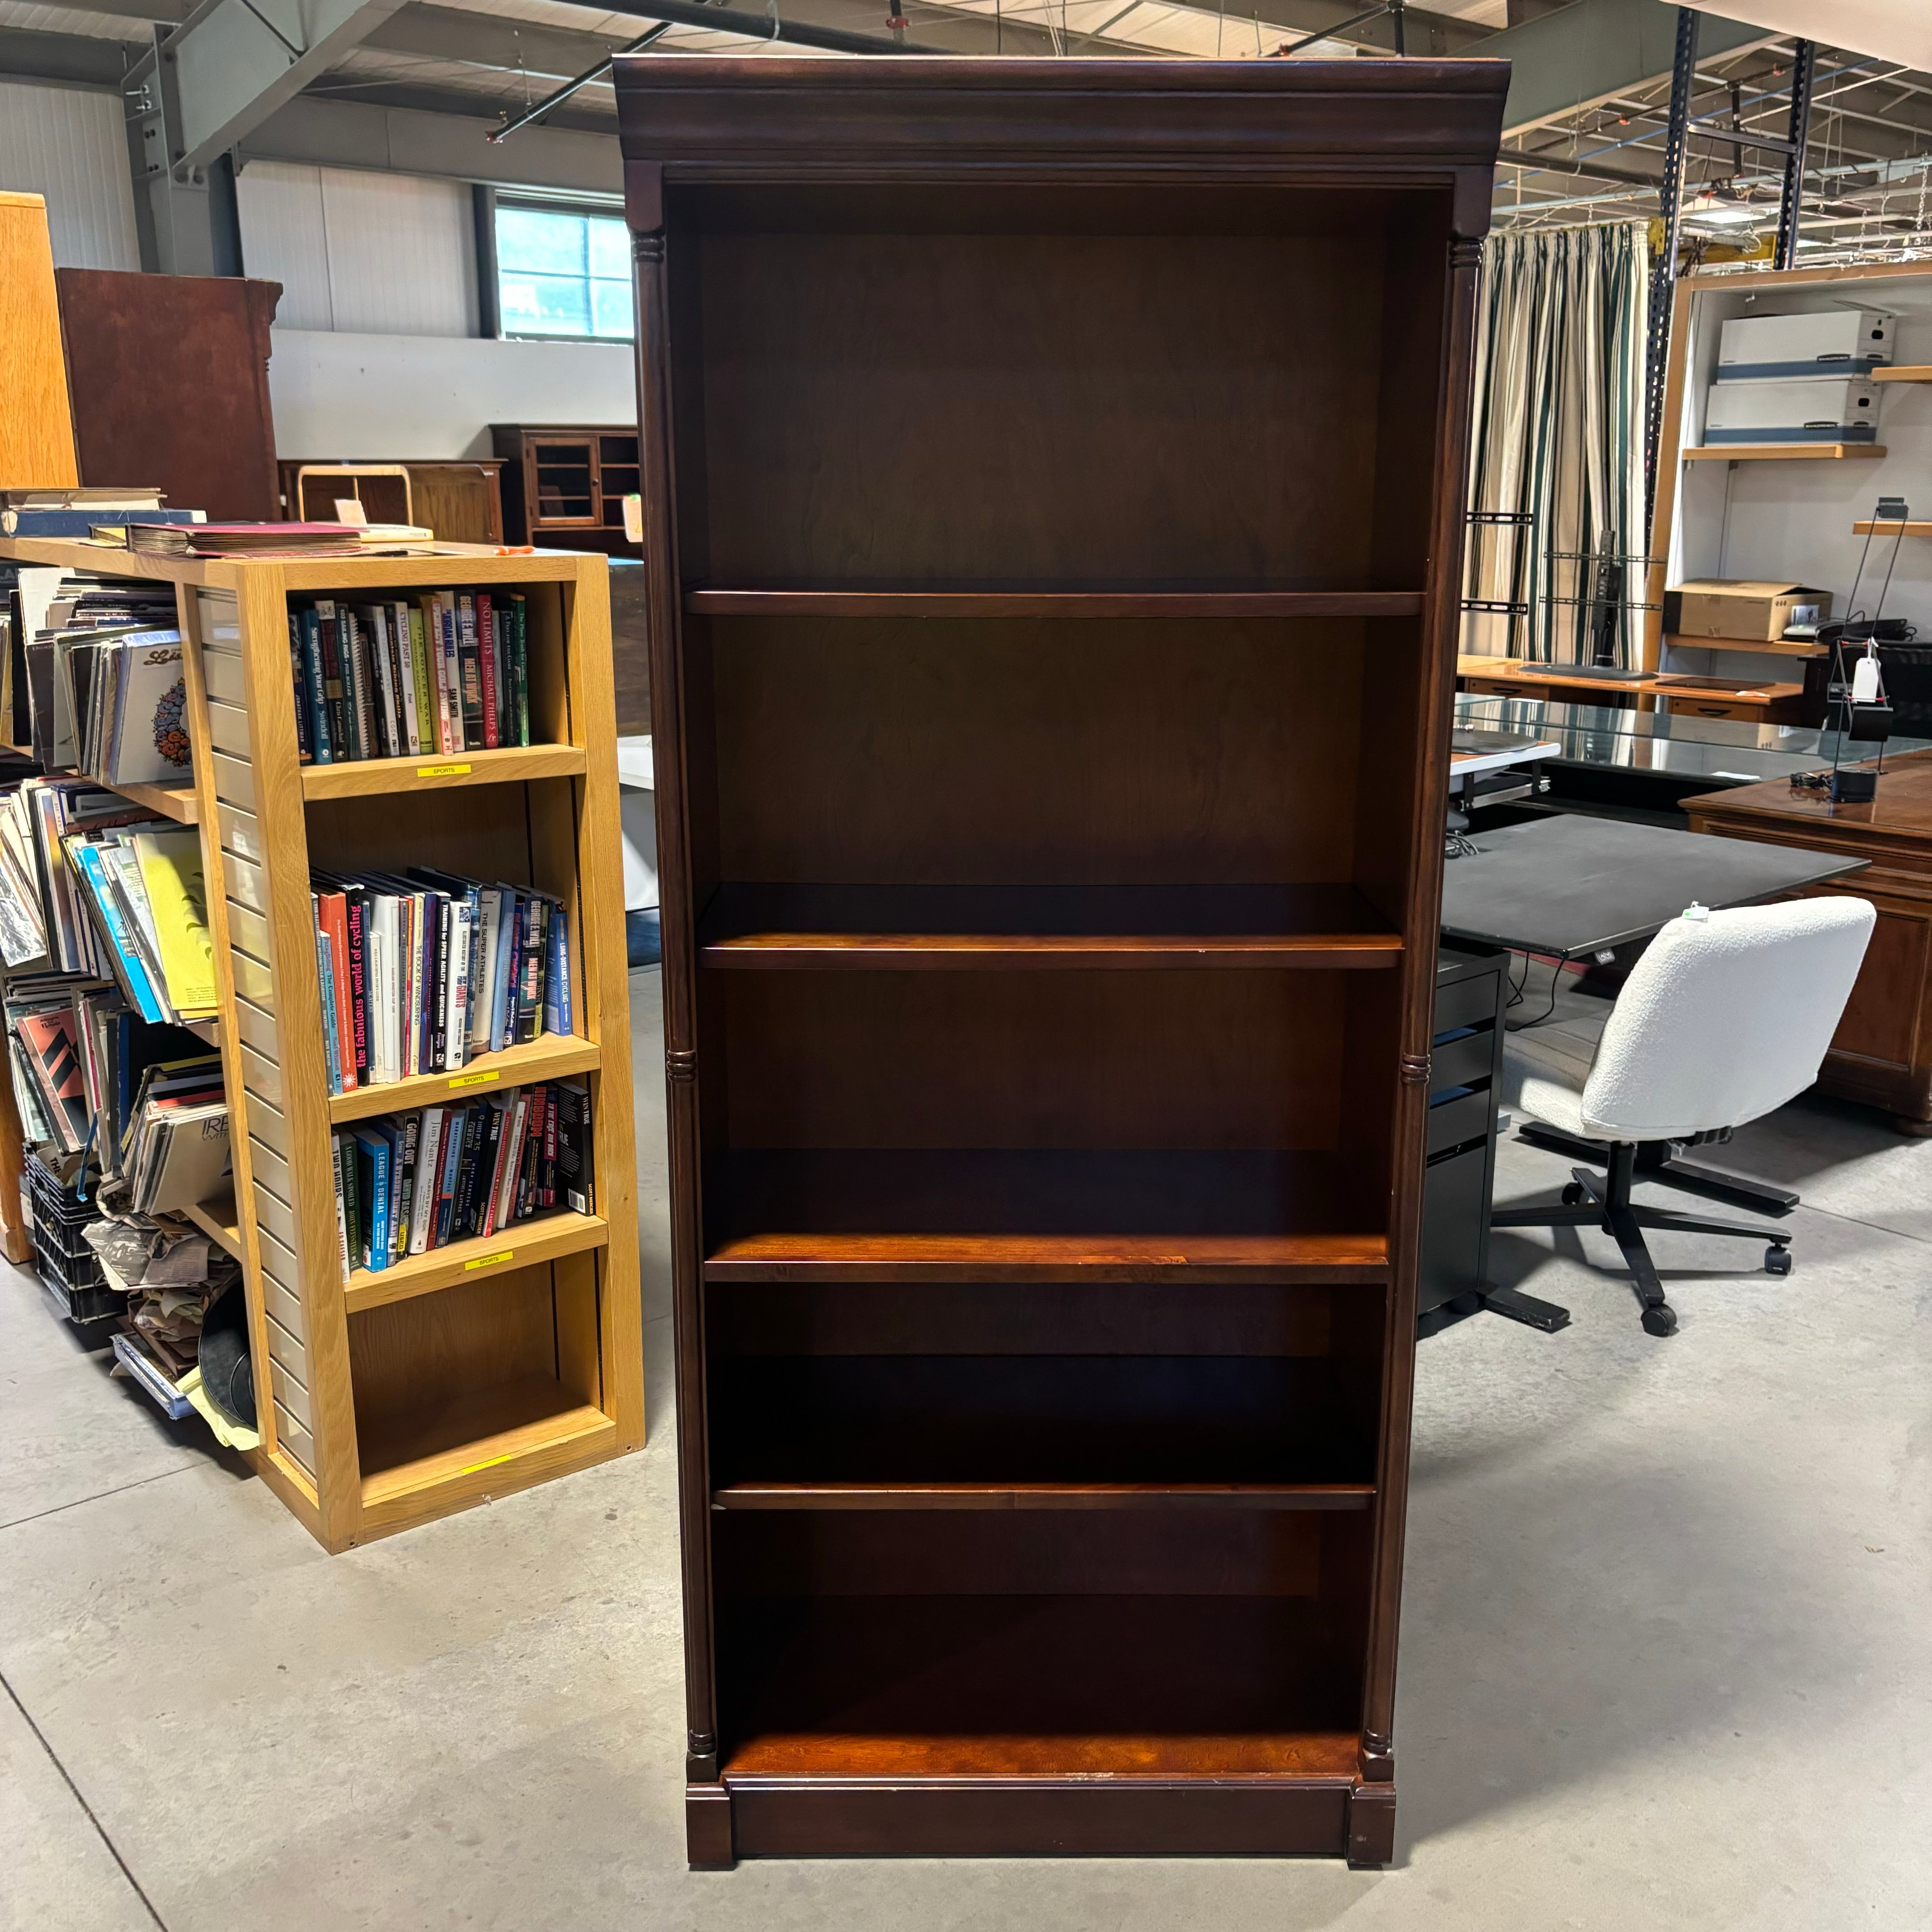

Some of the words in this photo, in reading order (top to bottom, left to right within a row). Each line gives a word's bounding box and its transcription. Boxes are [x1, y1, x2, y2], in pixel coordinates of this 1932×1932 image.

[460, 596, 473, 622] GEORGE
[483, 602, 491, 618] NO
[400, 612, 408, 642] CYCLING
[443, 614, 454, 639] JORDAN
[463, 629, 474, 645] WILL
[483, 621, 492, 654] LIMITS
[310, 627, 322, 673] Strengthening
[402, 644, 410, 660] PAST
[436, 647, 445, 668] YOUR
[445, 639, 455, 658] RULES
[419, 652, 428, 697] SOCCER
[465, 658, 476, 673] MEN
[315, 675, 323, 689] Your
[438, 670, 447, 691] GOLF
[465, 674, 476, 682] AT
[487, 665, 495, 699] MICHAEL
[316, 689, 325, 704] Grip
[449, 688, 457, 699] SAM
[466, 683, 478, 704] WORK
[440, 692, 450, 720] SWING
[450, 702, 459, 718] SMITH
[318, 711, 329, 739] Swindoll
[530, 901, 540, 925] GEORGE
[350, 905, 362, 946] cycling
[529, 930, 540, 945] WILL
[350, 948, 362, 960] of
[528, 958, 538, 972] MEN
[352, 963, 364, 995] world
[415, 975, 421, 984] OF
[455, 985, 467, 1007] GIANTS
[527, 980, 537, 1000] WORK
[354, 998, 366, 1048] fabulous
[356, 1049, 366, 1067] the
[492, 1112, 501, 1125] WIN
[530, 1087, 547, 1137] KINGDOM
[405, 1123, 417, 1148] GOING
[431, 1122, 441, 1137] Jim
[490, 1126, 499, 1140] TRUE
[451, 1122, 460, 1158] MARATHONING
[474, 1141, 481, 1150] 35
[404, 1150, 415, 1165] OUT
[428, 1141, 438, 1168] Nantz
[334, 1172, 342, 1199] HOURS
[424, 1210, 429, 1218] MY
[479, 1256, 499, 1265] SPORTS
